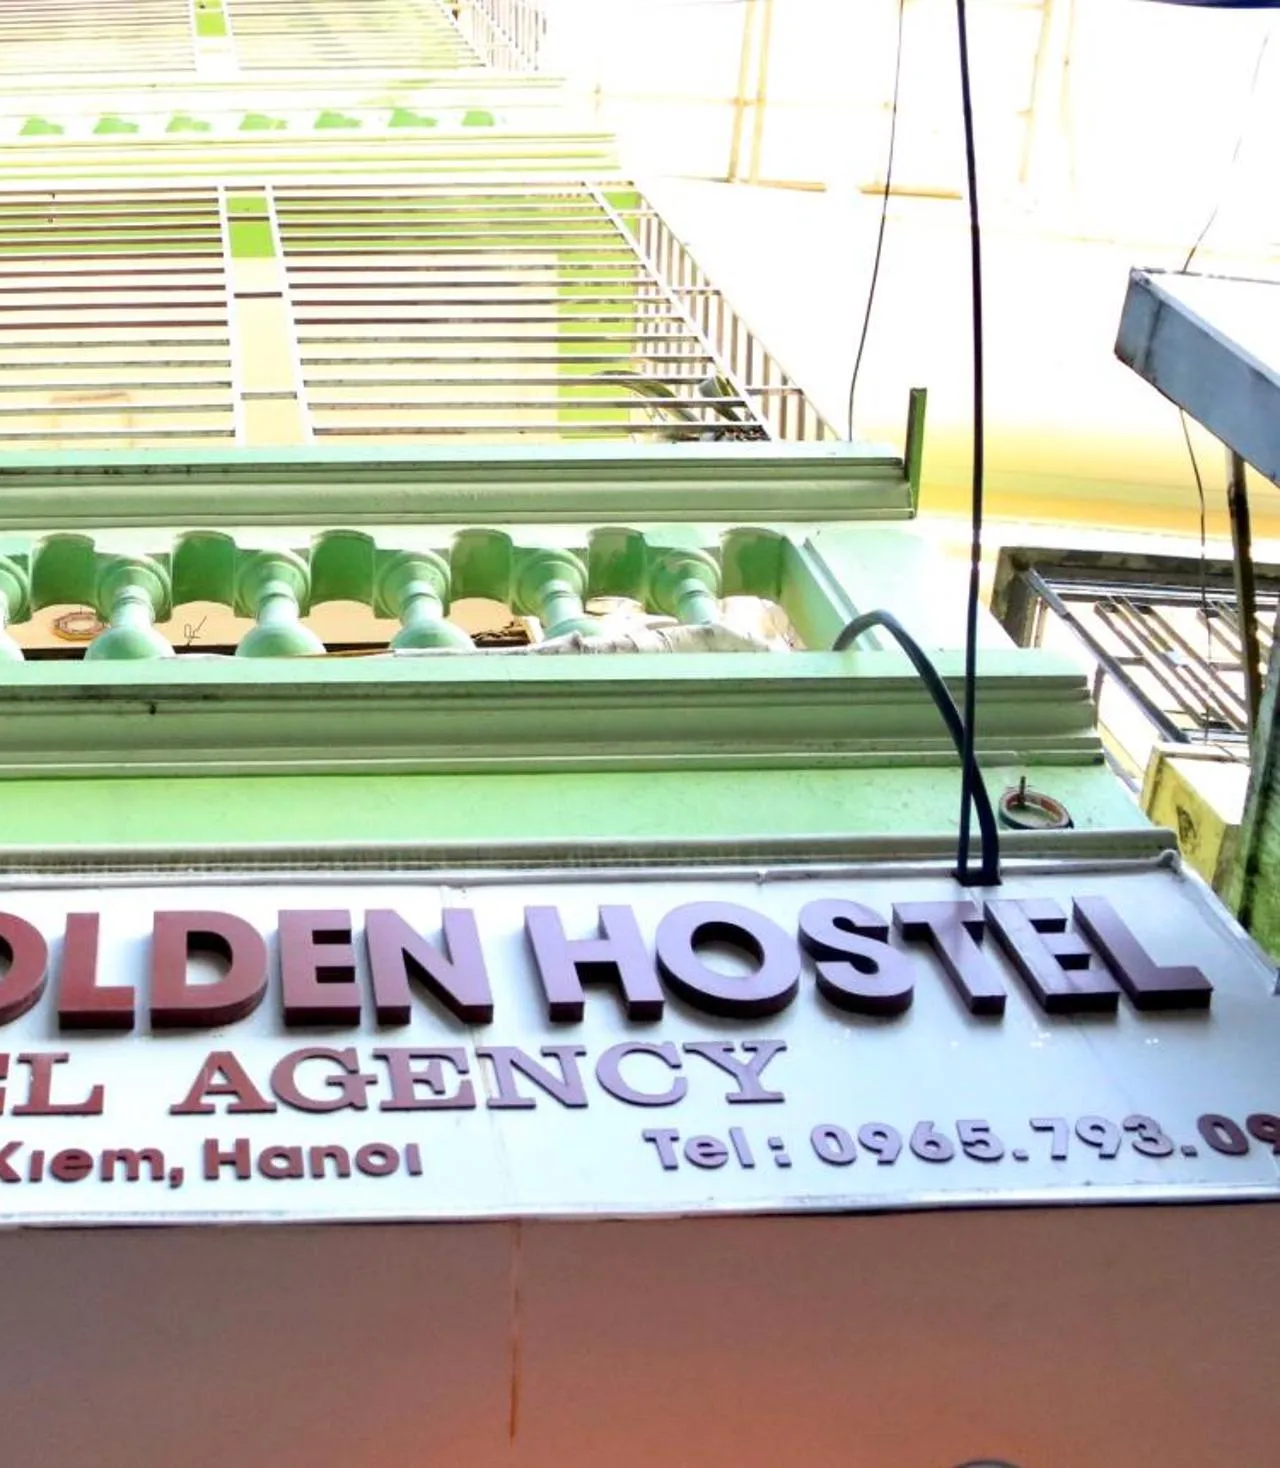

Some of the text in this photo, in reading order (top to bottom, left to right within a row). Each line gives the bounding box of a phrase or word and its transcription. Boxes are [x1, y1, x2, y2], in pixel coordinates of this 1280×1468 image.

[523, 893, 1213, 1025] HOSTEL
[169, 1038, 788, 1115] AGENCY
[202, 1137, 423, 1180] Hanoi
[642, 1126, 792, 1170] Tel:
